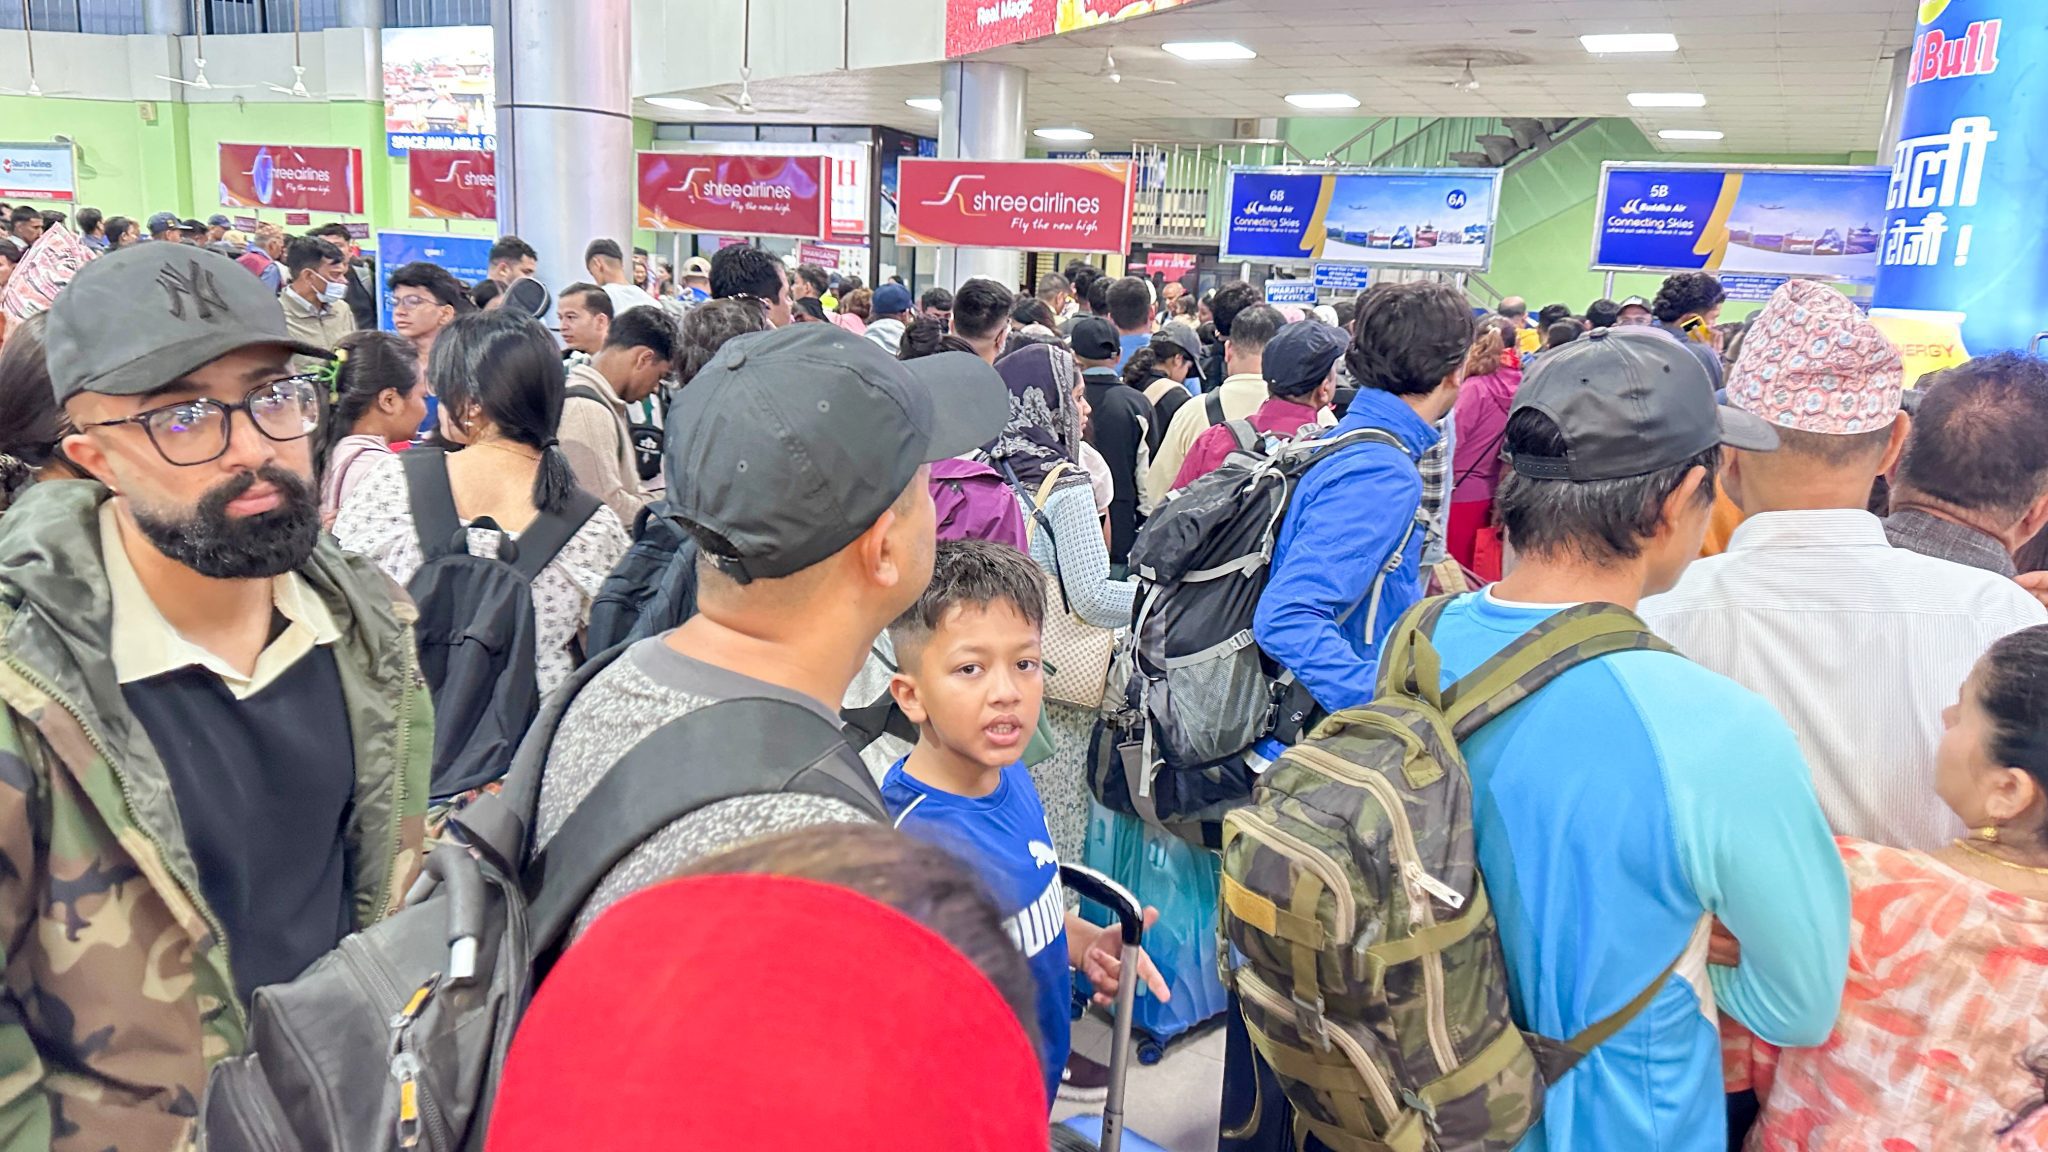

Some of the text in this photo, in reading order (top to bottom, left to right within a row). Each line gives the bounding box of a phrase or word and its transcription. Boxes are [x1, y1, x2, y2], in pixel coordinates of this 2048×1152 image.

[977, 1, 1000, 26] Real
[1919, 18, 2002, 83] Bull
[1269, 189, 1285, 202] 6B
[1649, 184, 1669, 198] 5B
[1448, 193, 1465, 206] 6A
[731, 201, 744, 213] Fly
[745, 201, 757, 210] the
[775, 203, 791, 215] high
[1283, 205, 1295, 213] Air
[1639, 203, 1687, 212] Buddha Air
[1010, 217, 1097, 236] Fly the new high
[1234, 216, 1300, 229] Connecting Skies
[1607, 216, 1694, 229] Connecting Skies
